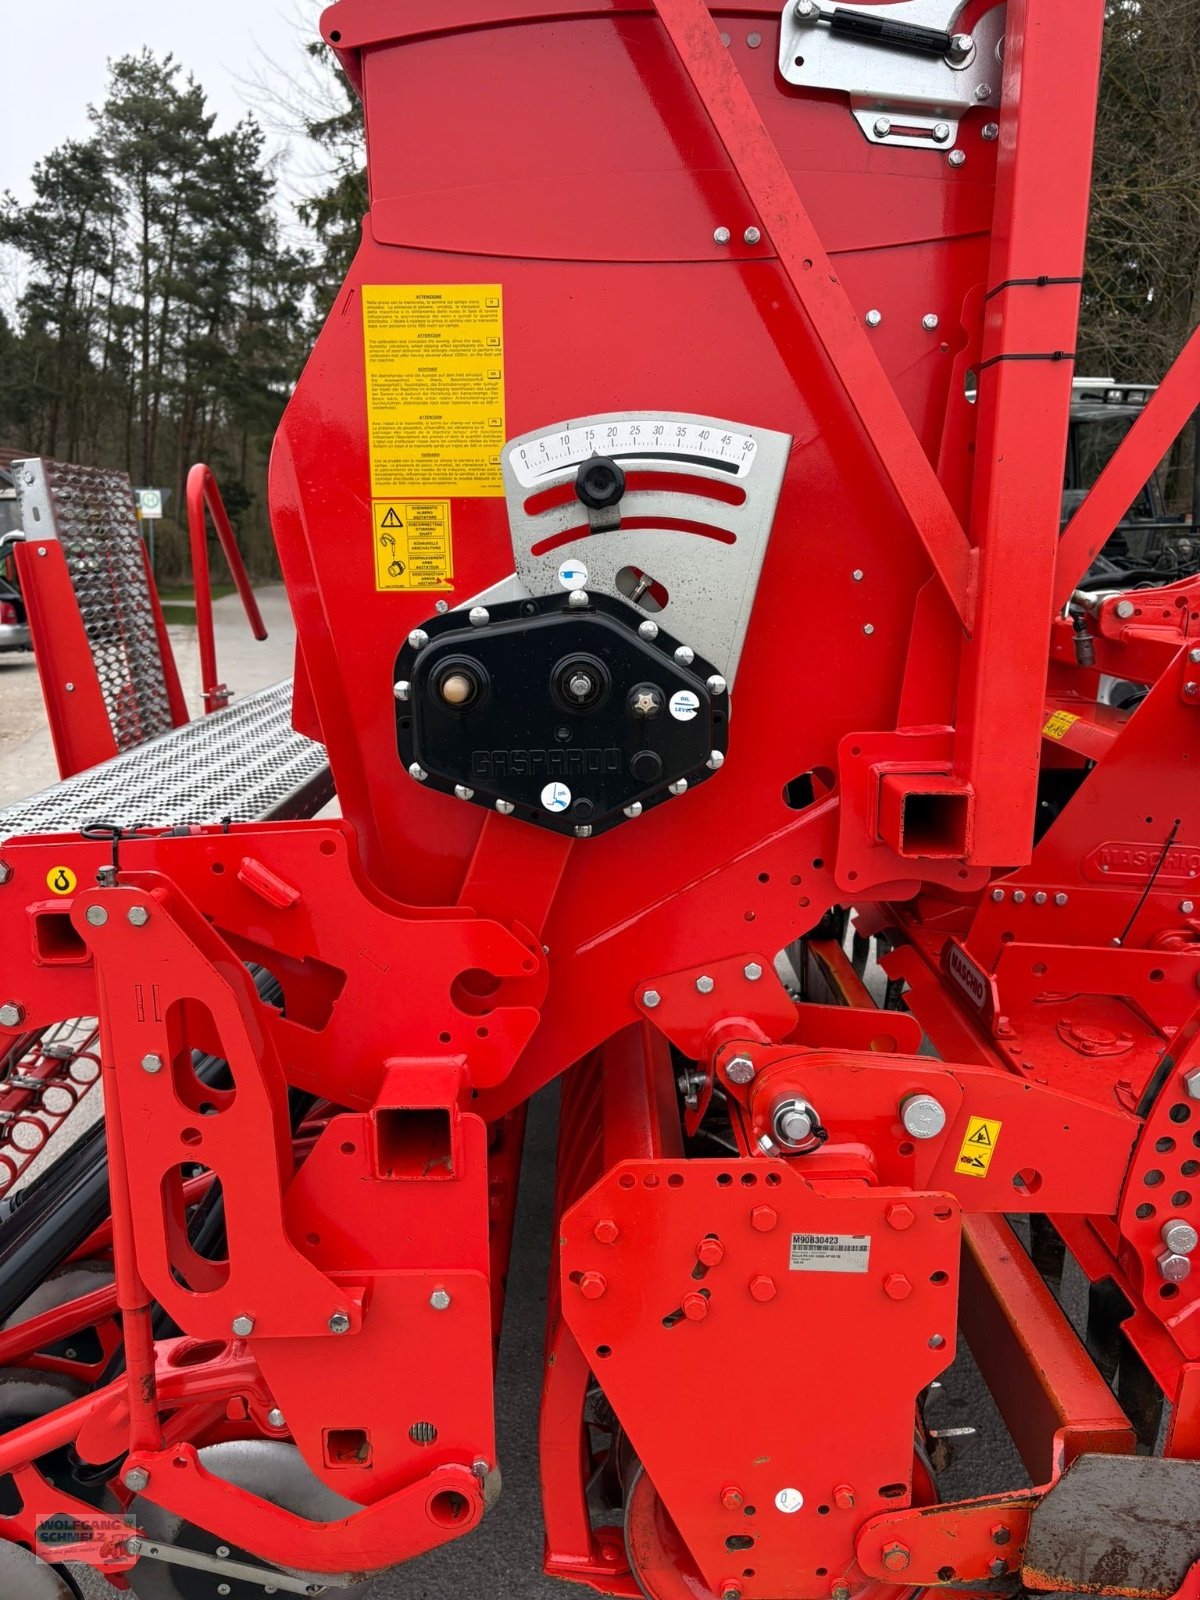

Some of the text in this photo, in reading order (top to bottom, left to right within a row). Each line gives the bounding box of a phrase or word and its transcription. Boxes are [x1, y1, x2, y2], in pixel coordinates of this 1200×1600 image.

[520, 425, 755, 460] 0 5 10 15 20 25 30 35 40 45 50
[472, 747, 622, 777] GASPARDO
[951, 951, 983, 1000] MASCHIO
[793, 1236, 839, 1244] M90B30423
